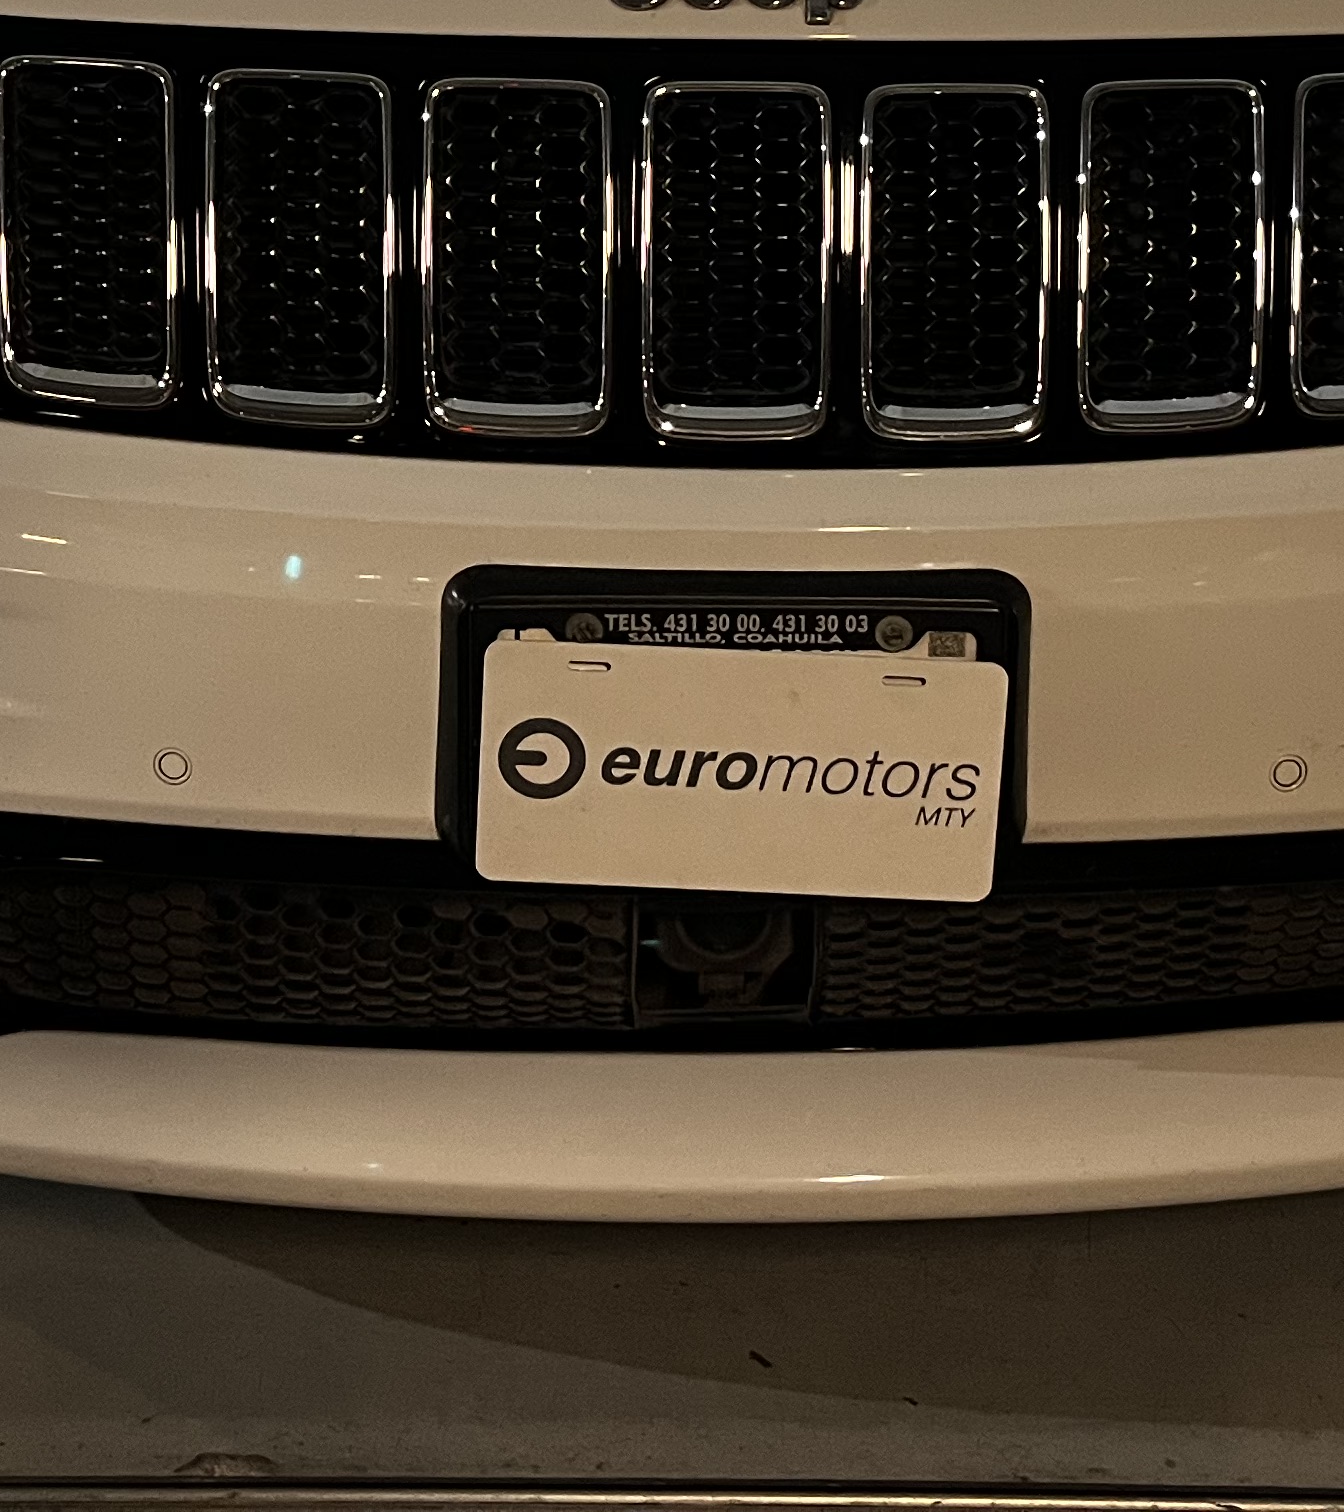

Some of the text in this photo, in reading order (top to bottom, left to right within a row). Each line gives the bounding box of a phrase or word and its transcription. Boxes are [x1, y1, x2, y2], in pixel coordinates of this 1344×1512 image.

[603, 613, 657, 632] TELS.
[663, 613, 697, 632] 431
[706, 613, 730, 632] 30
[772, 614, 806, 633] 431
[814, 614, 839, 633] 30
[844, 614, 868, 633] 03
[627, 632, 844, 645] SALTILLO, COAHUILA
[600, 745, 981, 802] euromotors
[914, 805, 976, 828] MTY
